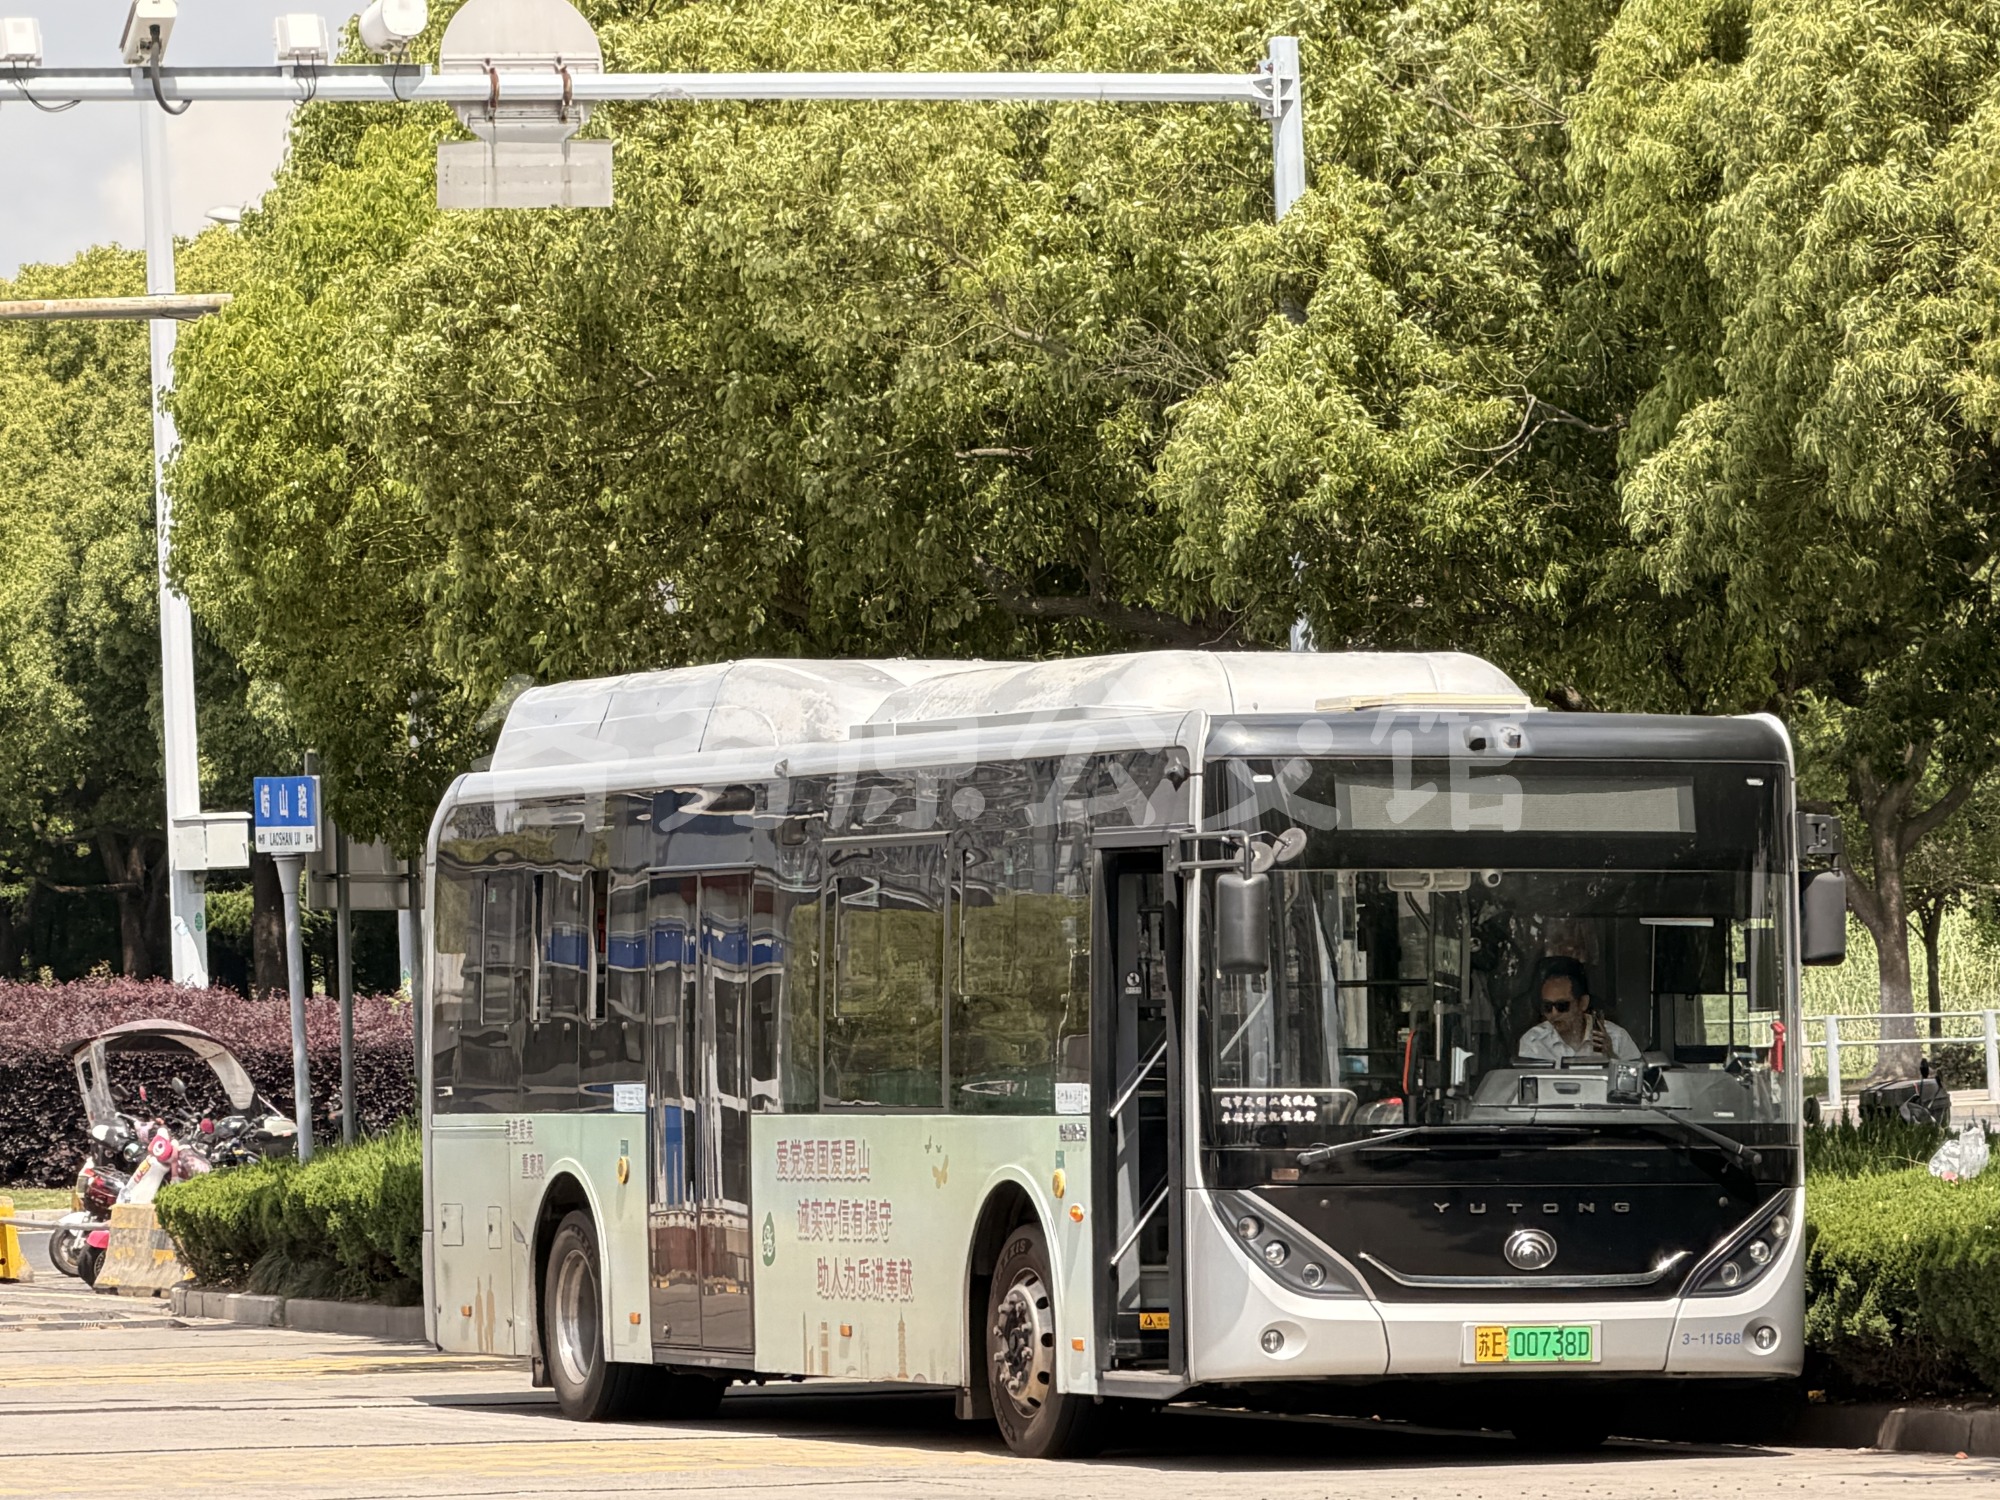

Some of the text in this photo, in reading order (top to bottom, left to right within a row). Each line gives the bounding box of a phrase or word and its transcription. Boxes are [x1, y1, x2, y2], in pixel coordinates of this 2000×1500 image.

[776, 1138, 871, 1179] 爱党爱国爱昆山
[797, 1198, 893, 1240] 诚实守信有操守
[1433, 1201, 1631, 1214] YUTONG
[816, 1256, 914, 1299] 助人为乐讲奉献
[1681, 1331, 1741, 1346] 3-11568
